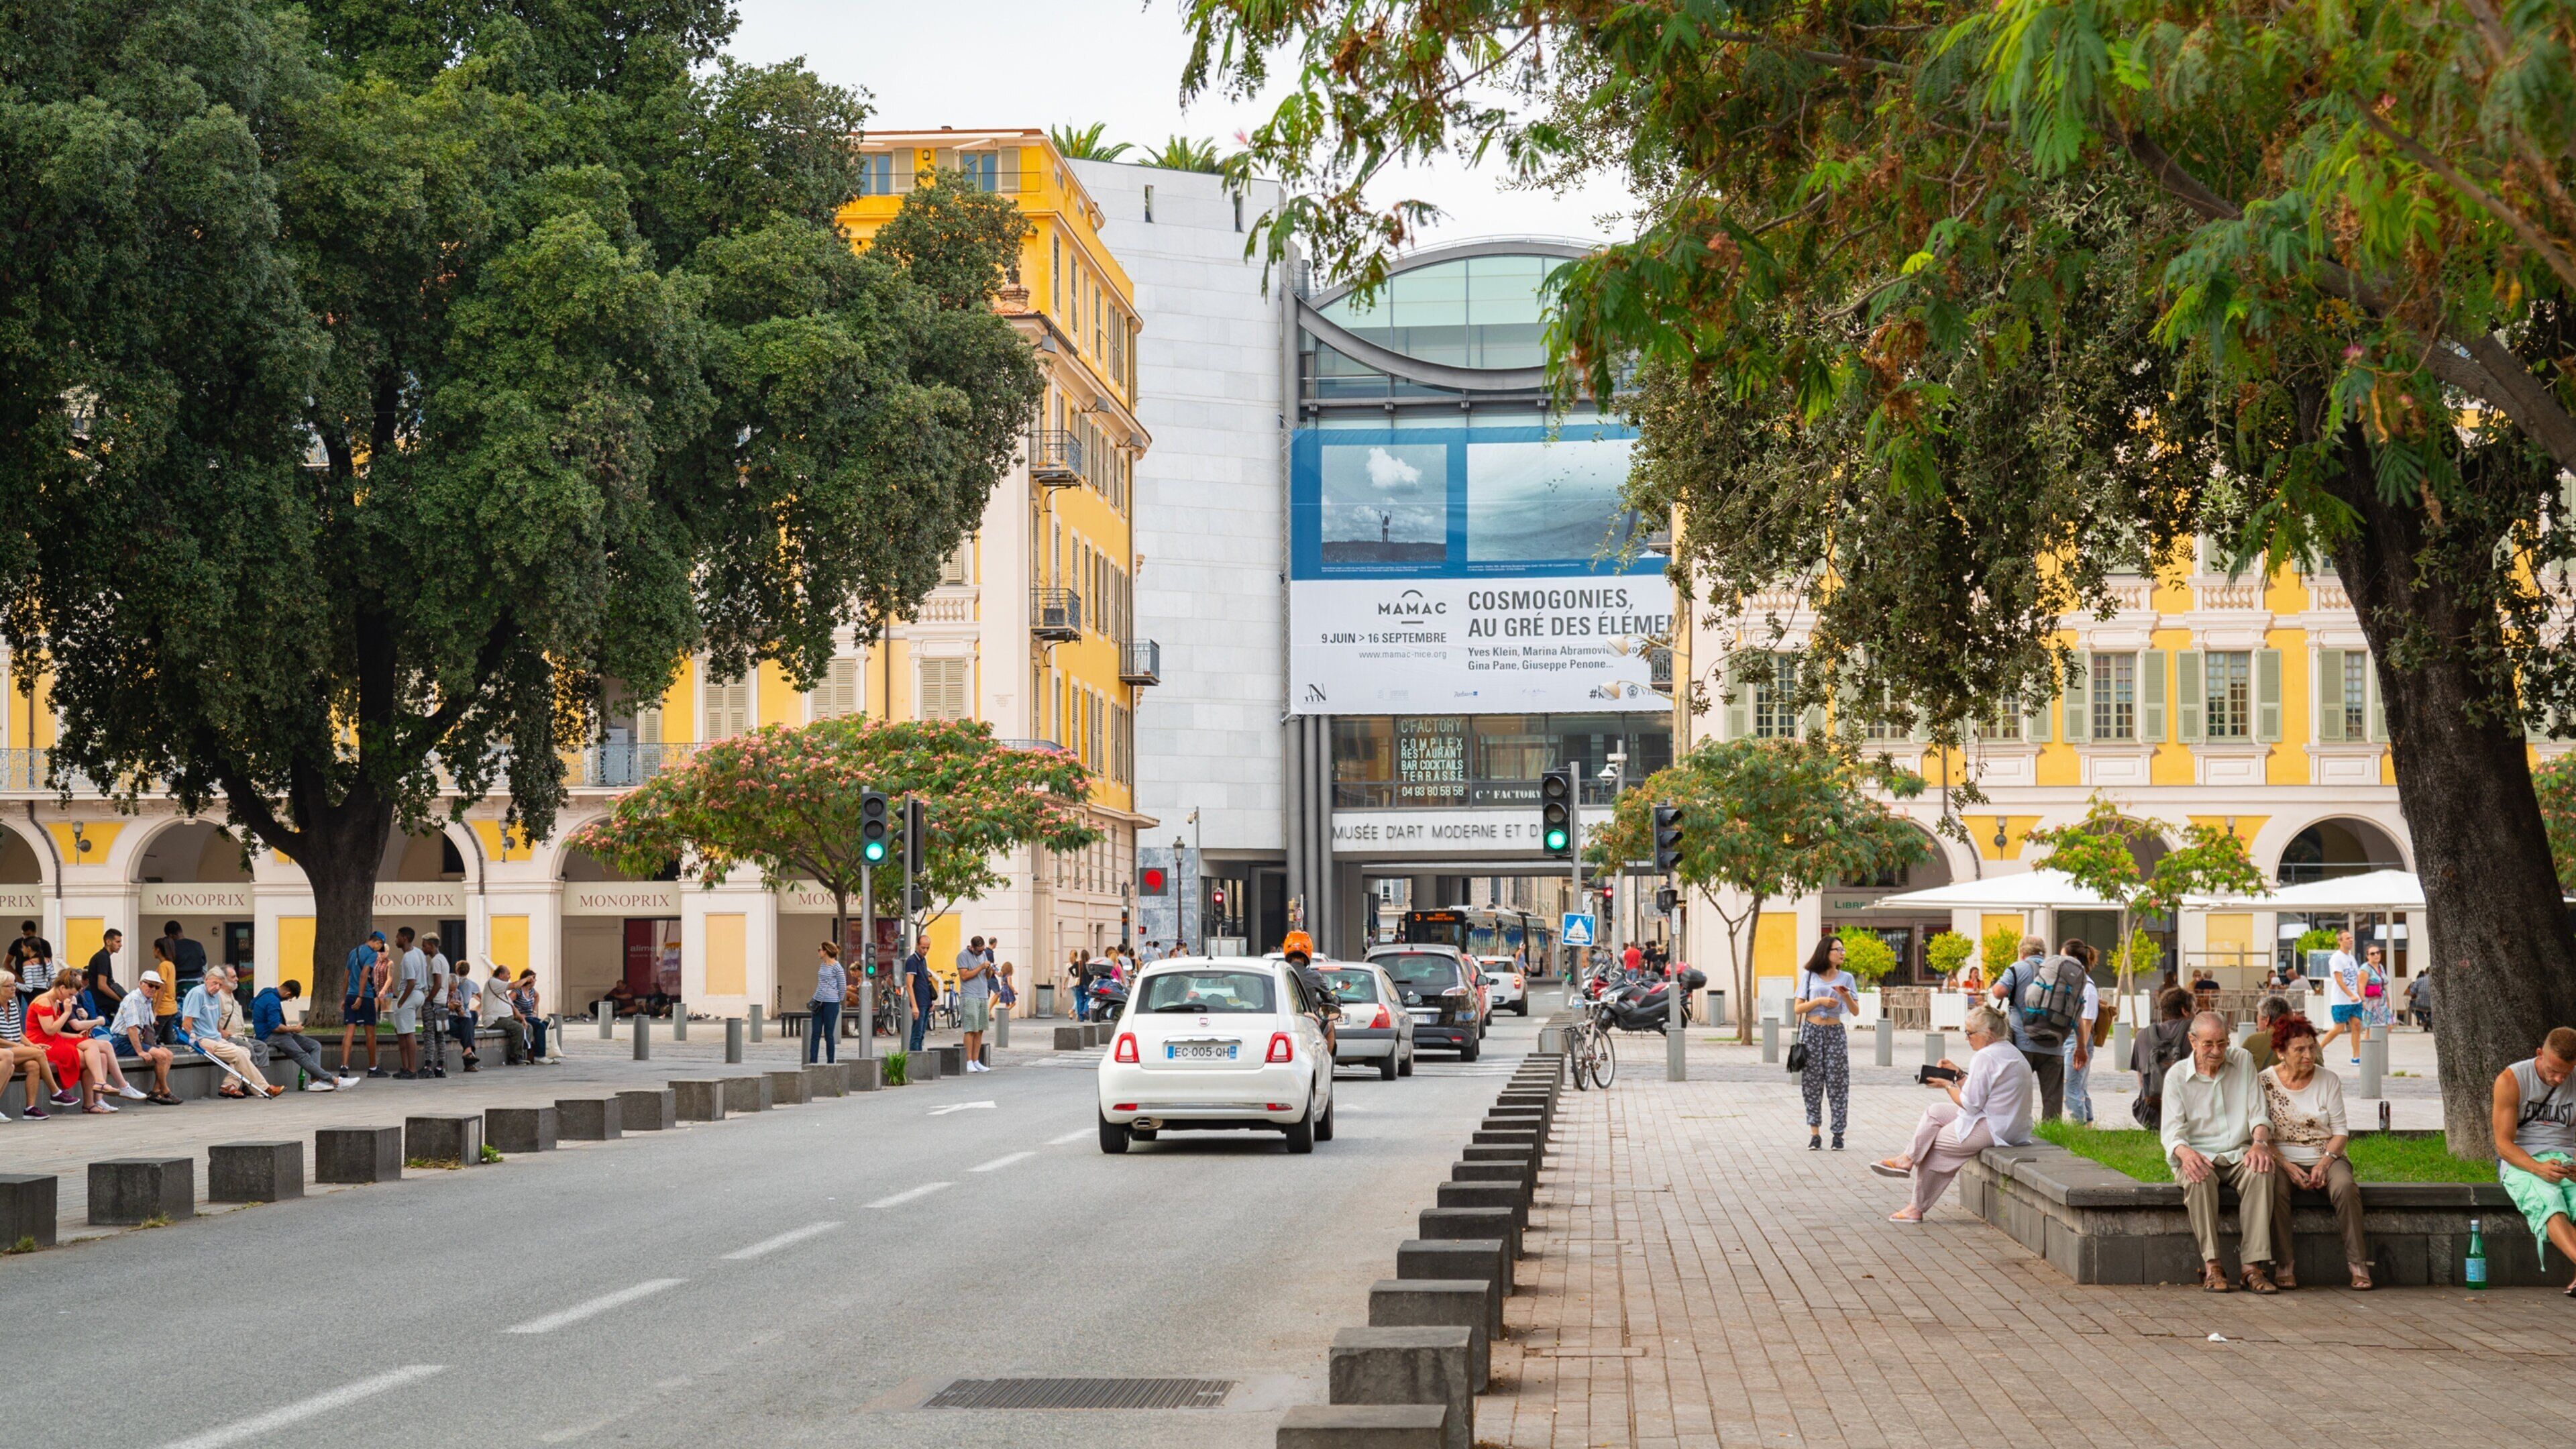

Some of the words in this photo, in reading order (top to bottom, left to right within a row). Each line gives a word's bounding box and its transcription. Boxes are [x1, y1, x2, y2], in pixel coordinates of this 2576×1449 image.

[1468, 588, 1634, 610] COSMOGONIES,
[1378, 602, 1447, 615] MAMAC
[1468, 618, 1497, 637] AU
[1504, 612, 1544, 637] GRÉ
[1551, 616, 1591, 637] DES
[1322, 633, 1328, 643] 9
[1330, 633, 1356, 643] JUIN
[1368, 633, 1379, 643] 16
[1382, 632, 1447, 643] SEPTEMBRE
[1359, 651, 1447, 659] www.mamac-nice.org
[1468, 647, 1491, 657] Yves
[1493, 646, 1520, 657] Klein,
[1523, 645, 1556, 656] Marina
[1468, 661, 1490, 670] Gina
[1493, 660, 1520, 671] Pane,
[1522, 659, 1567, 672] Giuseppe
[1401, 718, 1462, 733] C'FACTORY
[1401, 737, 1463, 749] COMPLEX
[1401, 748, 1462, 759] RESTAURANT
[1401, 759, 1417, 771] BAR
[1419, 759, 1464, 770] COCKTAILS
[1401, 771, 1464, 782] TERRASSE
[1402, 786, 1412, 796] 04
[1415, 786, 1425, 796] 93
[1428, 786, 1438, 796] 80
[1440, 786, 1451, 796] 58
[1453, 786, 1464, 796] 58
[1493, 790, 1542, 800] FACTORY
[1332, 823, 1378, 840] MUSÉE
[1386, 824, 1424, 839] D'ART
[1432, 824, 1497, 839] MODERNE
[1505, 823, 1521, 838] ET
[156, 894, 246, 906] MONOPRIX
[580, 894, 670, 907] MONOPRIX
[1415, 913, 1421, 922] 3
